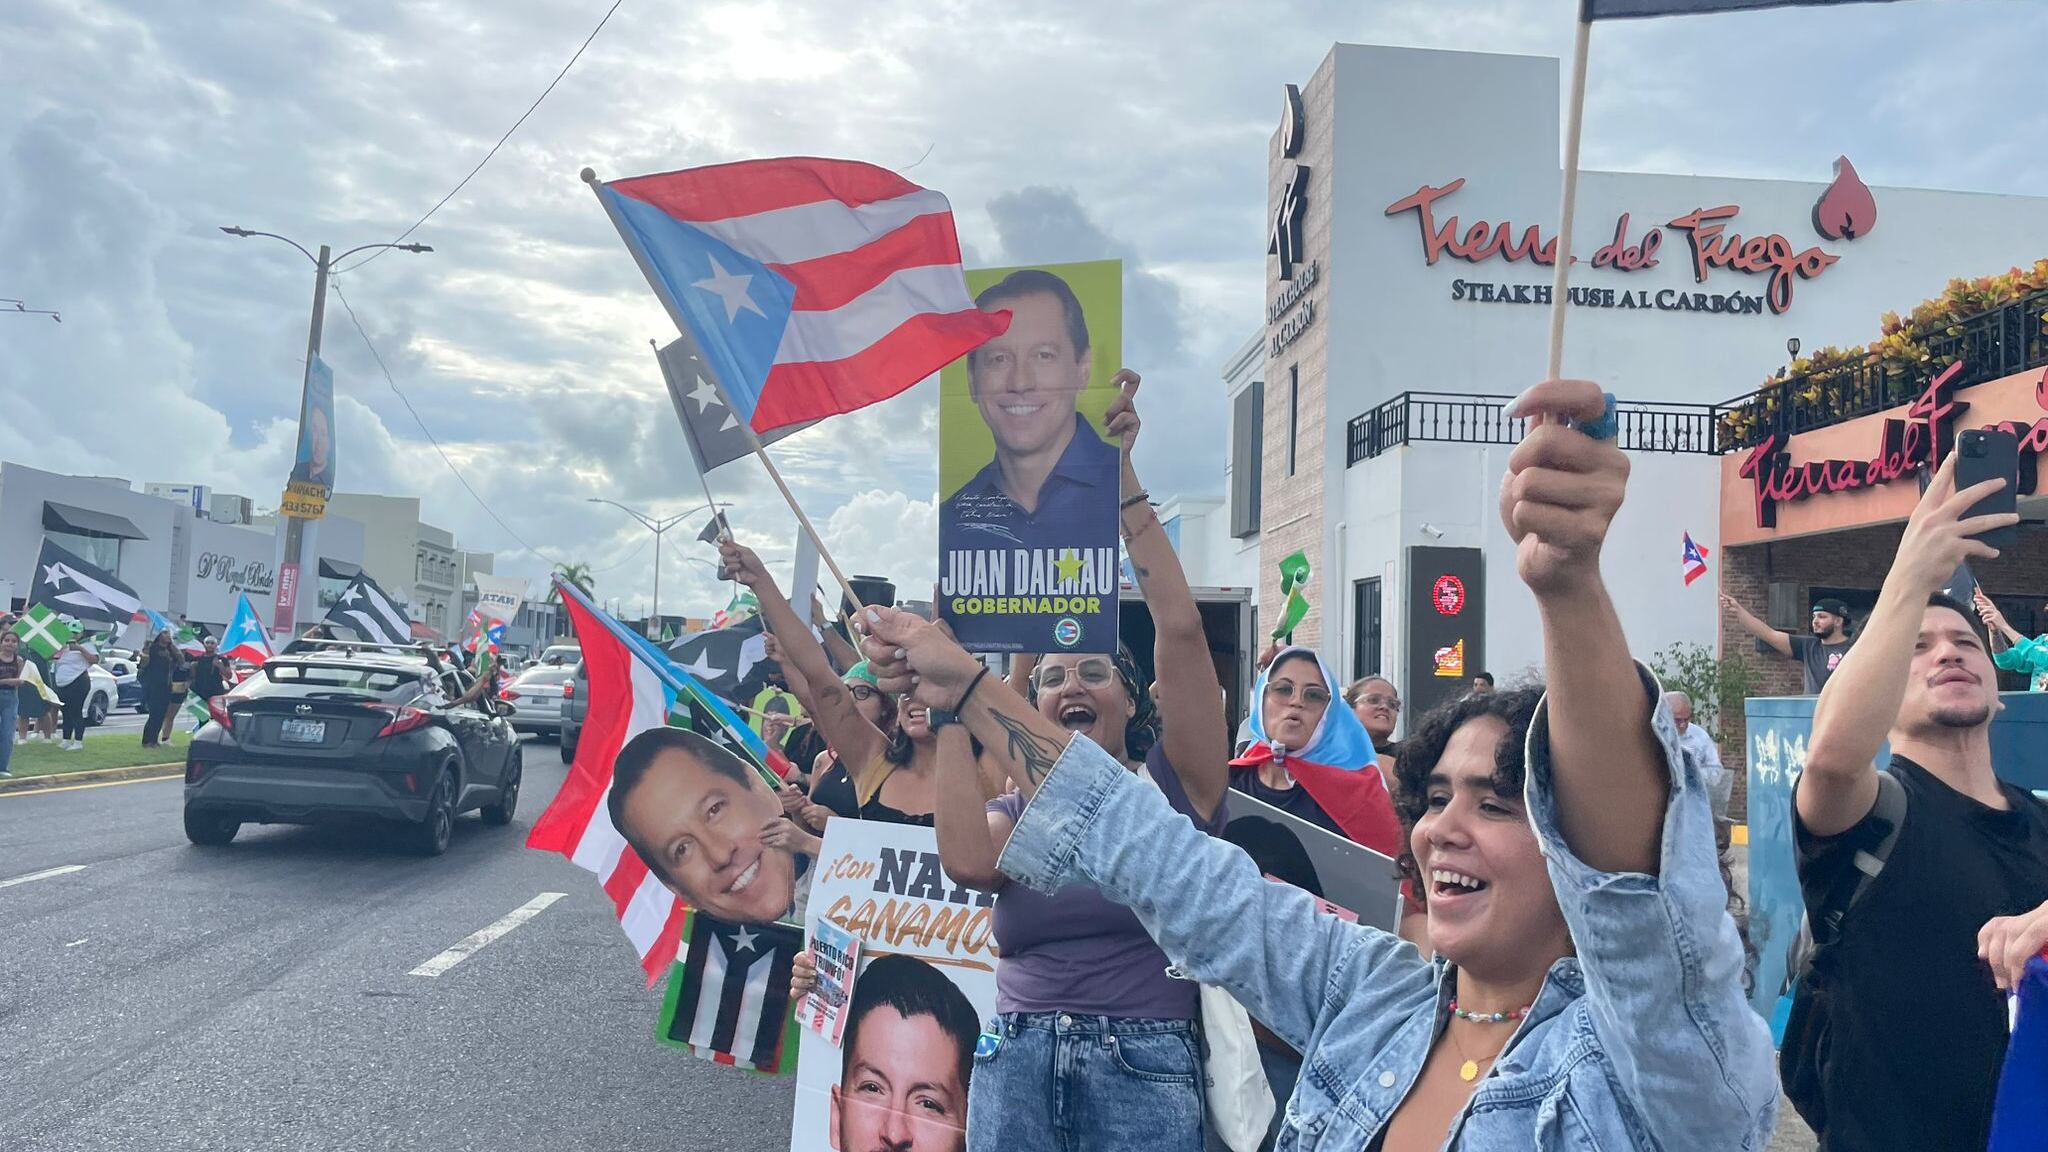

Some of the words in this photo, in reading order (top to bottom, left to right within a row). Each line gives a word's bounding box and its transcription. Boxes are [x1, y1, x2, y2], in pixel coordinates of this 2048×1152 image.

[1590, 212, 1660, 272] del
[1665, 205, 1841, 315] Fuego
[1452, 279, 1615, 308] STEAKHUSE
[1617, 289, 1653, 309] AL
[1655, 288, 1764, 314] CARBÓN
[1739, 433, 1857, 528] Tierra
[1865, 418, 1920, 485] del
[942, 549, 1007, 597] JUAN
[1013, 546, 1114, 597] DALMAU
[952, 597, 1101, 615] GOBERNADOR
[821, 852, 876, 884] ¡Con
[873, 847, 1000, 908] NA
[837, 949, 854, 971] RICO
